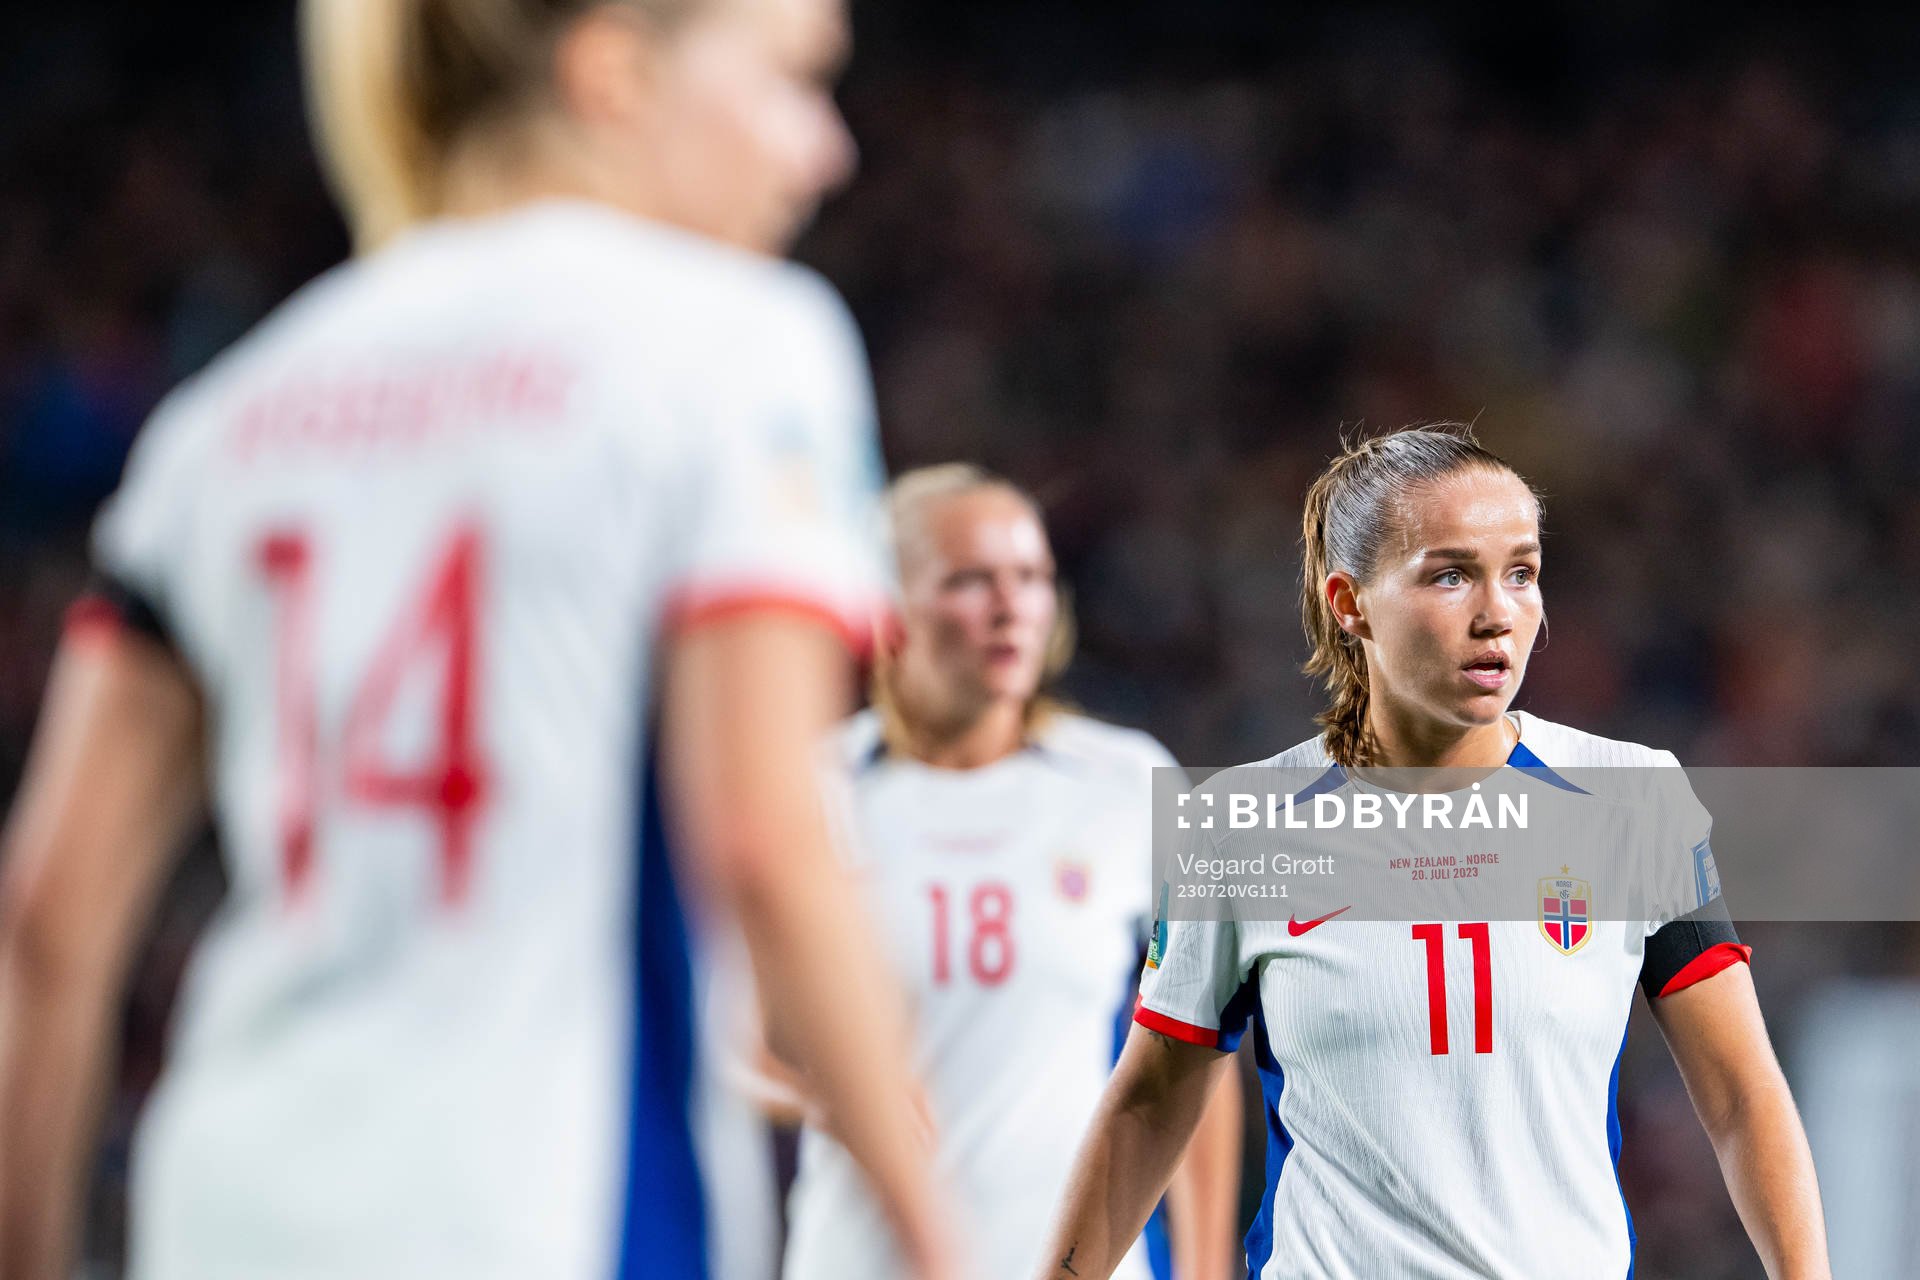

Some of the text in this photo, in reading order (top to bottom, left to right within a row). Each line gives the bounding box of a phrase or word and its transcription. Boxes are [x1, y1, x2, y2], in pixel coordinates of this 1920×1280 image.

[254, 518, 494, 908] 14
[1390, 857, 1411, 870] NEW
[1414, 855, 1457, 868] ZEALAND
[1466, 853, 1500, 866] NORGE
[1411, 866, 1479, 881] 20. JULI 2023
[924, 881, 1017, 987] 18
[1412, 922, 1493, 1056] 11
